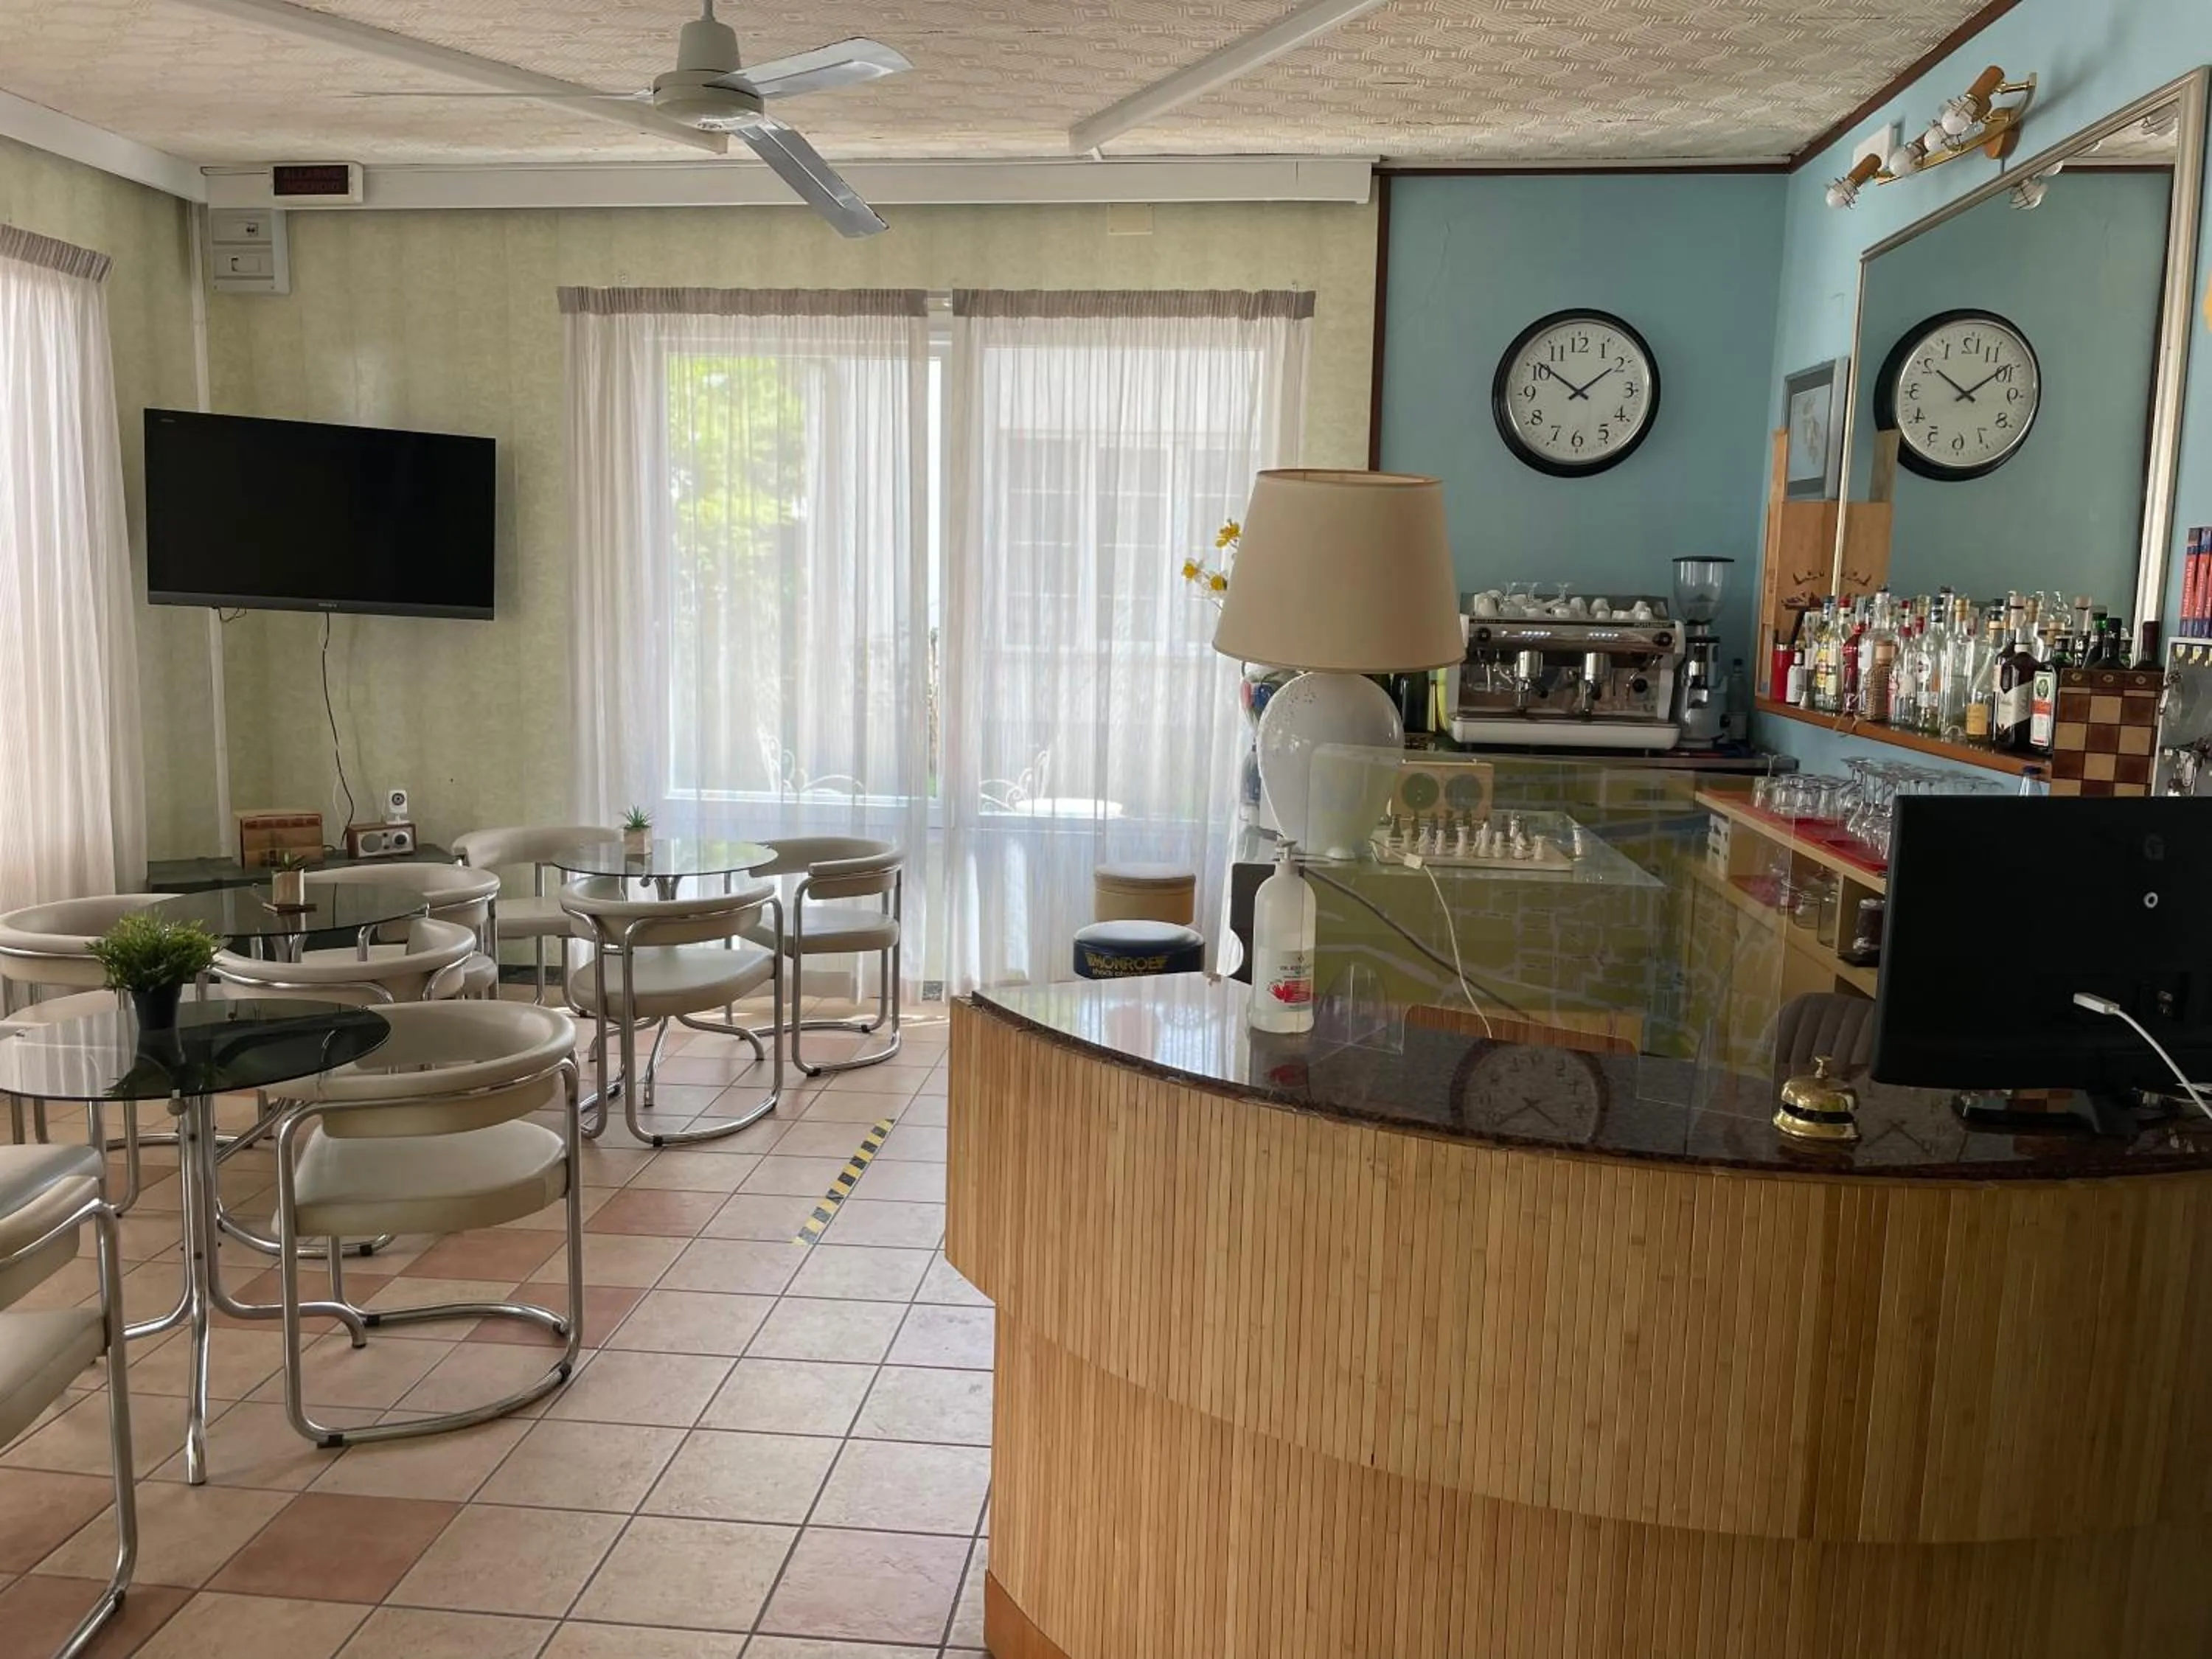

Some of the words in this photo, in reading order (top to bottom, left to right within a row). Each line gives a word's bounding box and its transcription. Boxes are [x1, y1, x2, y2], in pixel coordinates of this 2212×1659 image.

[1551, 345, 1564, 361] 11
[1570, 337, 1589, 353] 12
[1601, 343, 1605, 359] 1
[1532, 363, 1551, 380] 10
[1614, 357, 1625, 372] 2
[1523, 386, 1537, 403] 9
[1624, 381, 1635, 398] 3
[1531, 409, 1543, 425] 8
[1613, 406, 1626, 422] 4
[1551, 425, 1562, 442] 7
[1571, 431, 1584, 448] 6
[1598, 423, 1610, 444] 5
